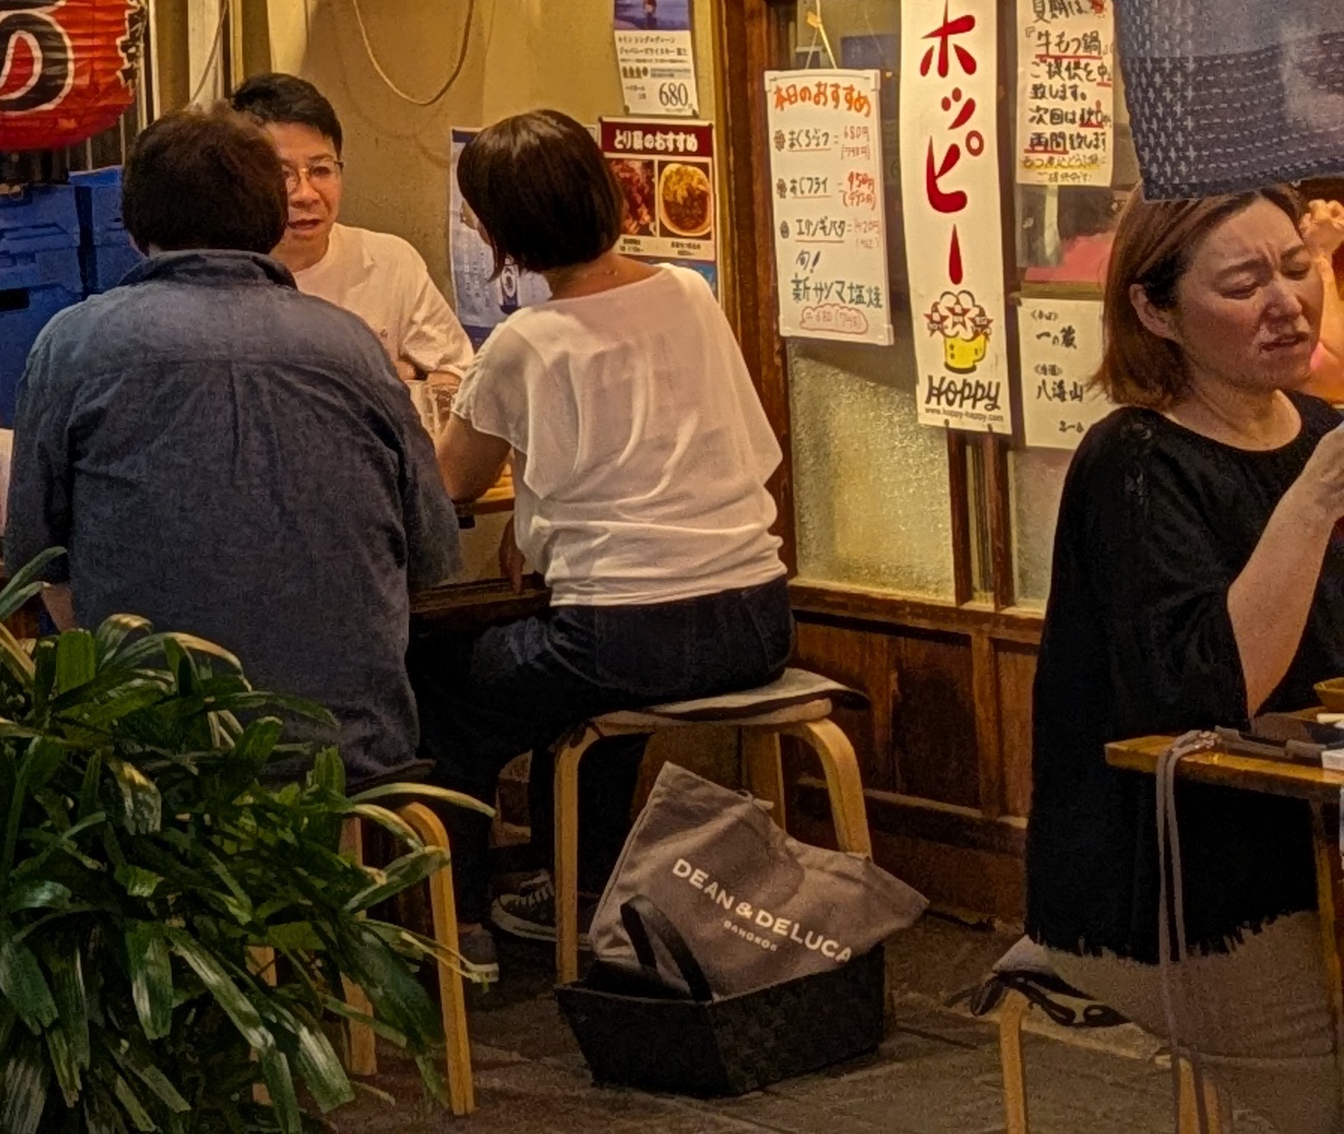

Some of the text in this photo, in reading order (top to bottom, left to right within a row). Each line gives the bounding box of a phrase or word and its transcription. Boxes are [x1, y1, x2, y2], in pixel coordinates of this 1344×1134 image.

[658, 82, 689, 107] 680
[773, 80, 872, 118] 本日のおすすめ
[1035, 378, 1084, 402] 八海山
[672, 858, 735, 910] DEAN
[754, 908, 853, 964] DELUCA
